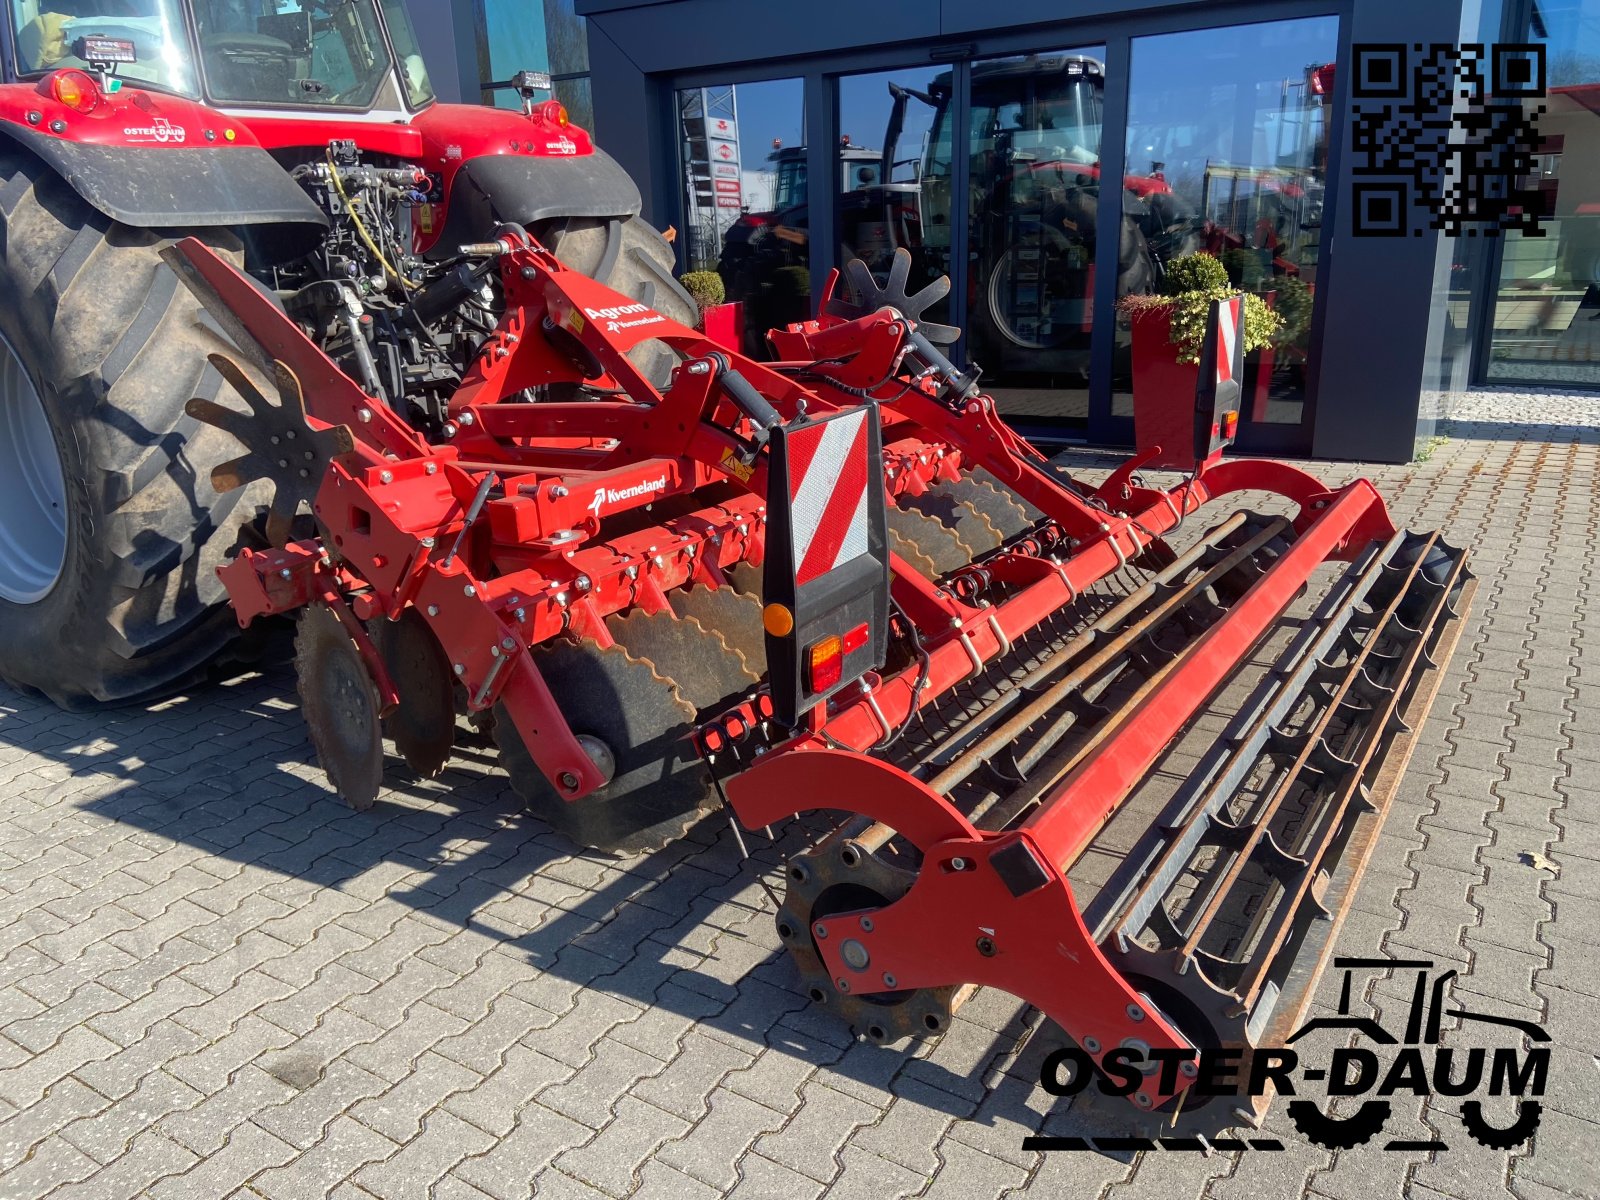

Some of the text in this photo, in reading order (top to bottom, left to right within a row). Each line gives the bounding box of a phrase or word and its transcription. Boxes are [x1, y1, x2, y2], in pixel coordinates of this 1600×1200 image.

[123, 127, 186, 136] OSTER-DAUM
[584, 303, 649, 320] Agrom
[607, 474, 666, 504] Kverneland
